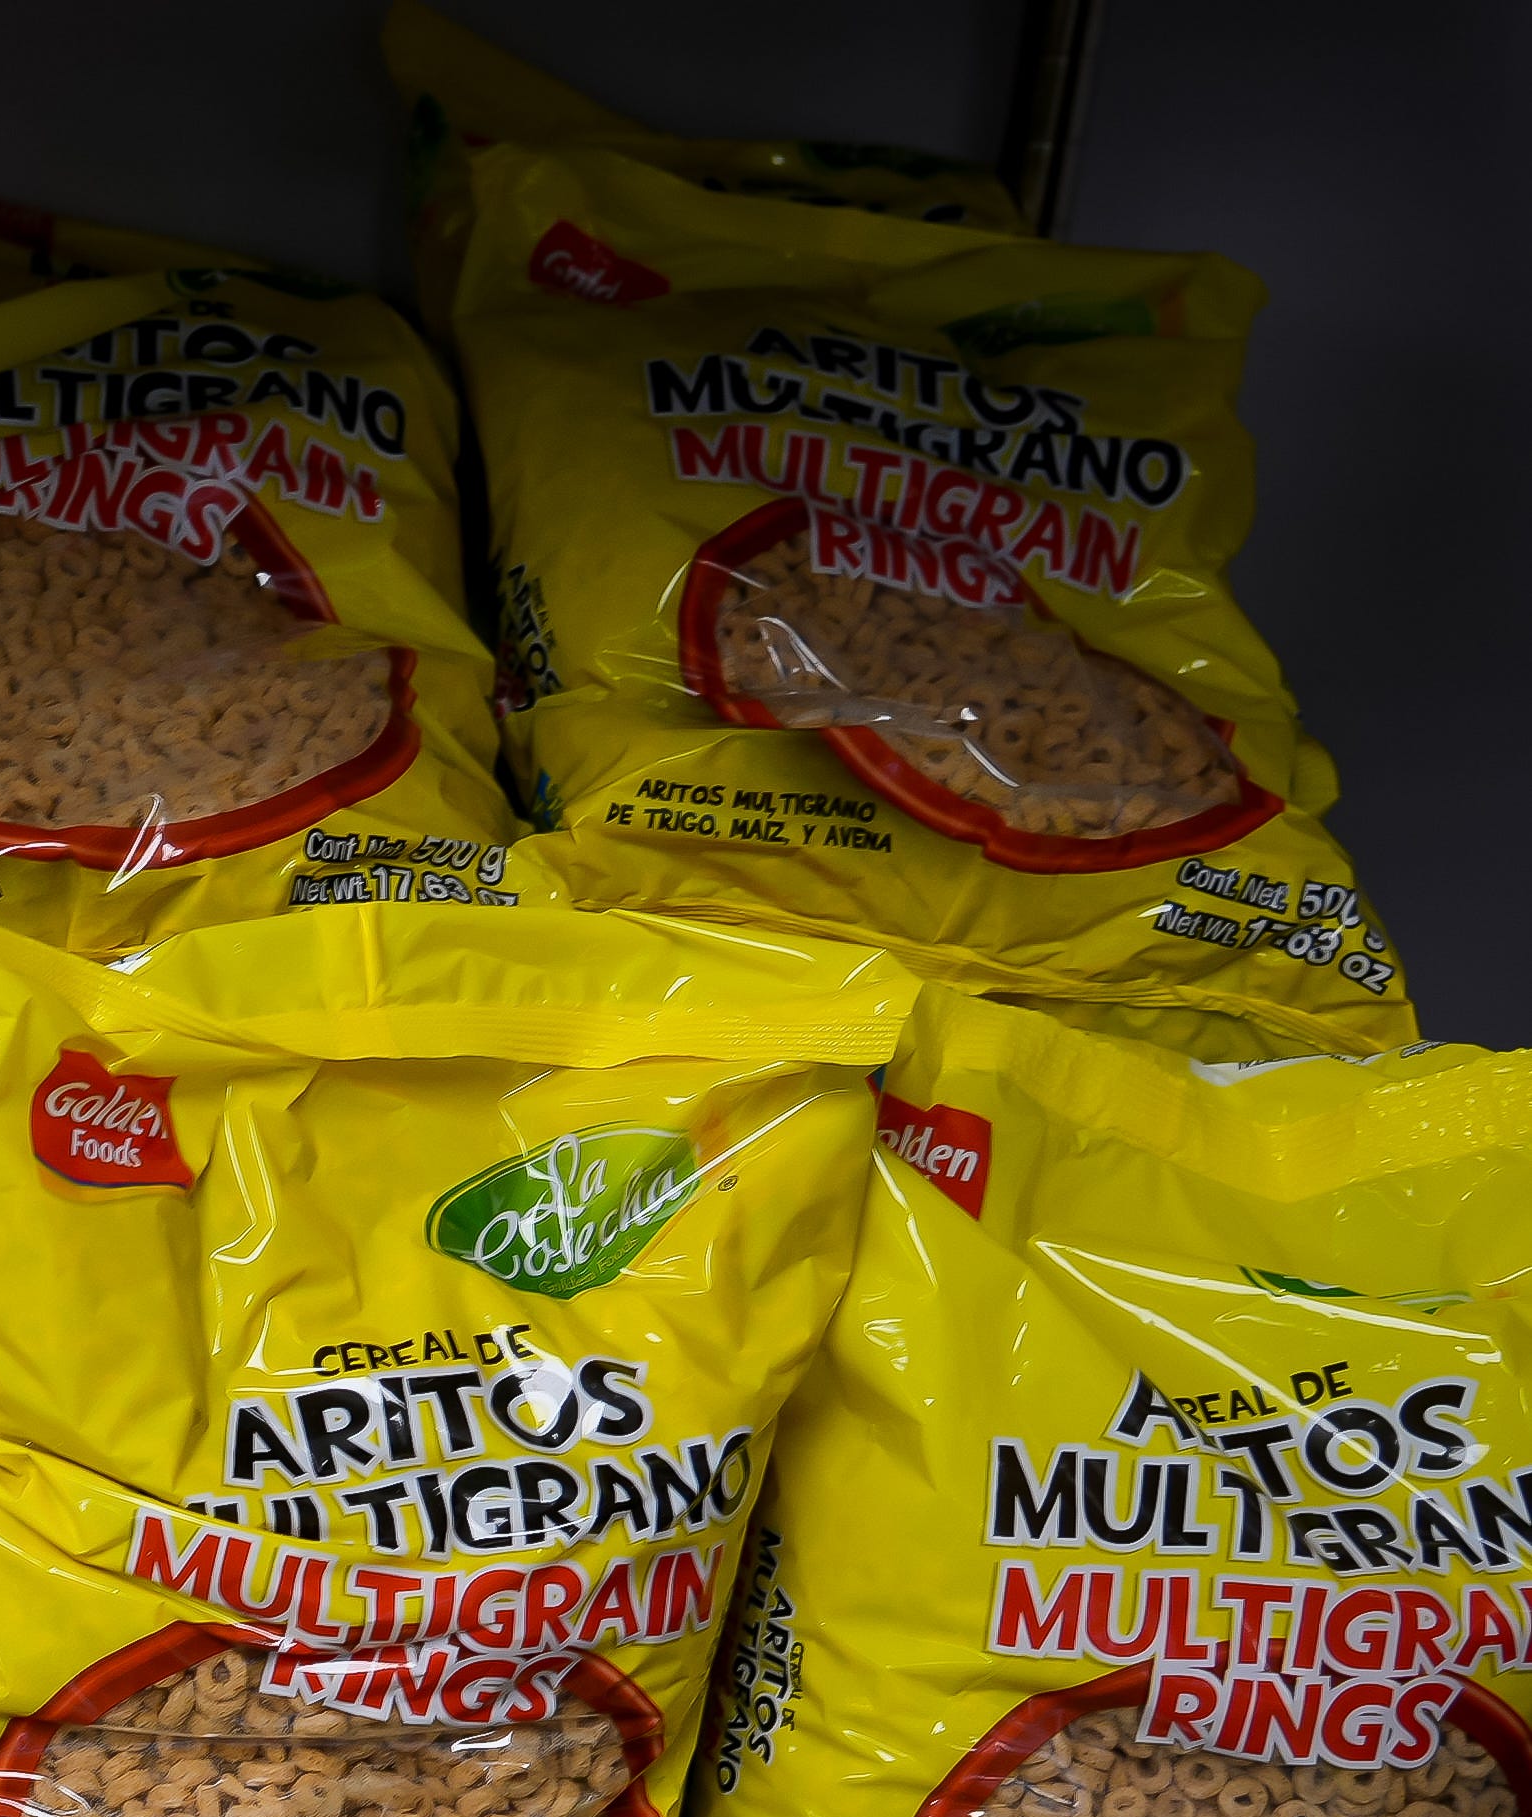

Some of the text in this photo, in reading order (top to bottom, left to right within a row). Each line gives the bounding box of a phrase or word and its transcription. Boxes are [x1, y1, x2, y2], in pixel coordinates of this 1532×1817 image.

[672, 423, 1140, 599] MULTIGRAIN
[604, 802, 635, 825] DE
[643, 808, 720, 838] TRIGO,
[802, 824, 817, 846] Y
[823, 825, 893, 853] AVENA
[636, 778, 876, 823] ARITOS MULTIGRANO
[290, 874, 329, 904] Net
[410, 834, 481, 871] 500
[477, 845, 507, 885] g
[1154, 901, 1203, 938] Net
[1340, 951, 1395, 996] oz
[43, 1078, 168, 1142] Golden
[69, 1127, 142, 1169] Foods
[521, 1133, 608, 1220] La
[461, 1168, 685, 1281] Cosecha
[311, 1322, 534, 1379] CEREAL DE
[1291, 1360, 1353, 1405] DE
[226, 1356, 648, 1488] ARITOS
[1117, 1368, 1477, 1502] ATOS
[126, 1502, 730, 1652] MULTIGRAIN
[992, 1561, 1532, 1677] MULTIGRA
[746, 1583, 797, 1767] ARITOS
[1136, 1669, 1464, 1768] RINGS
